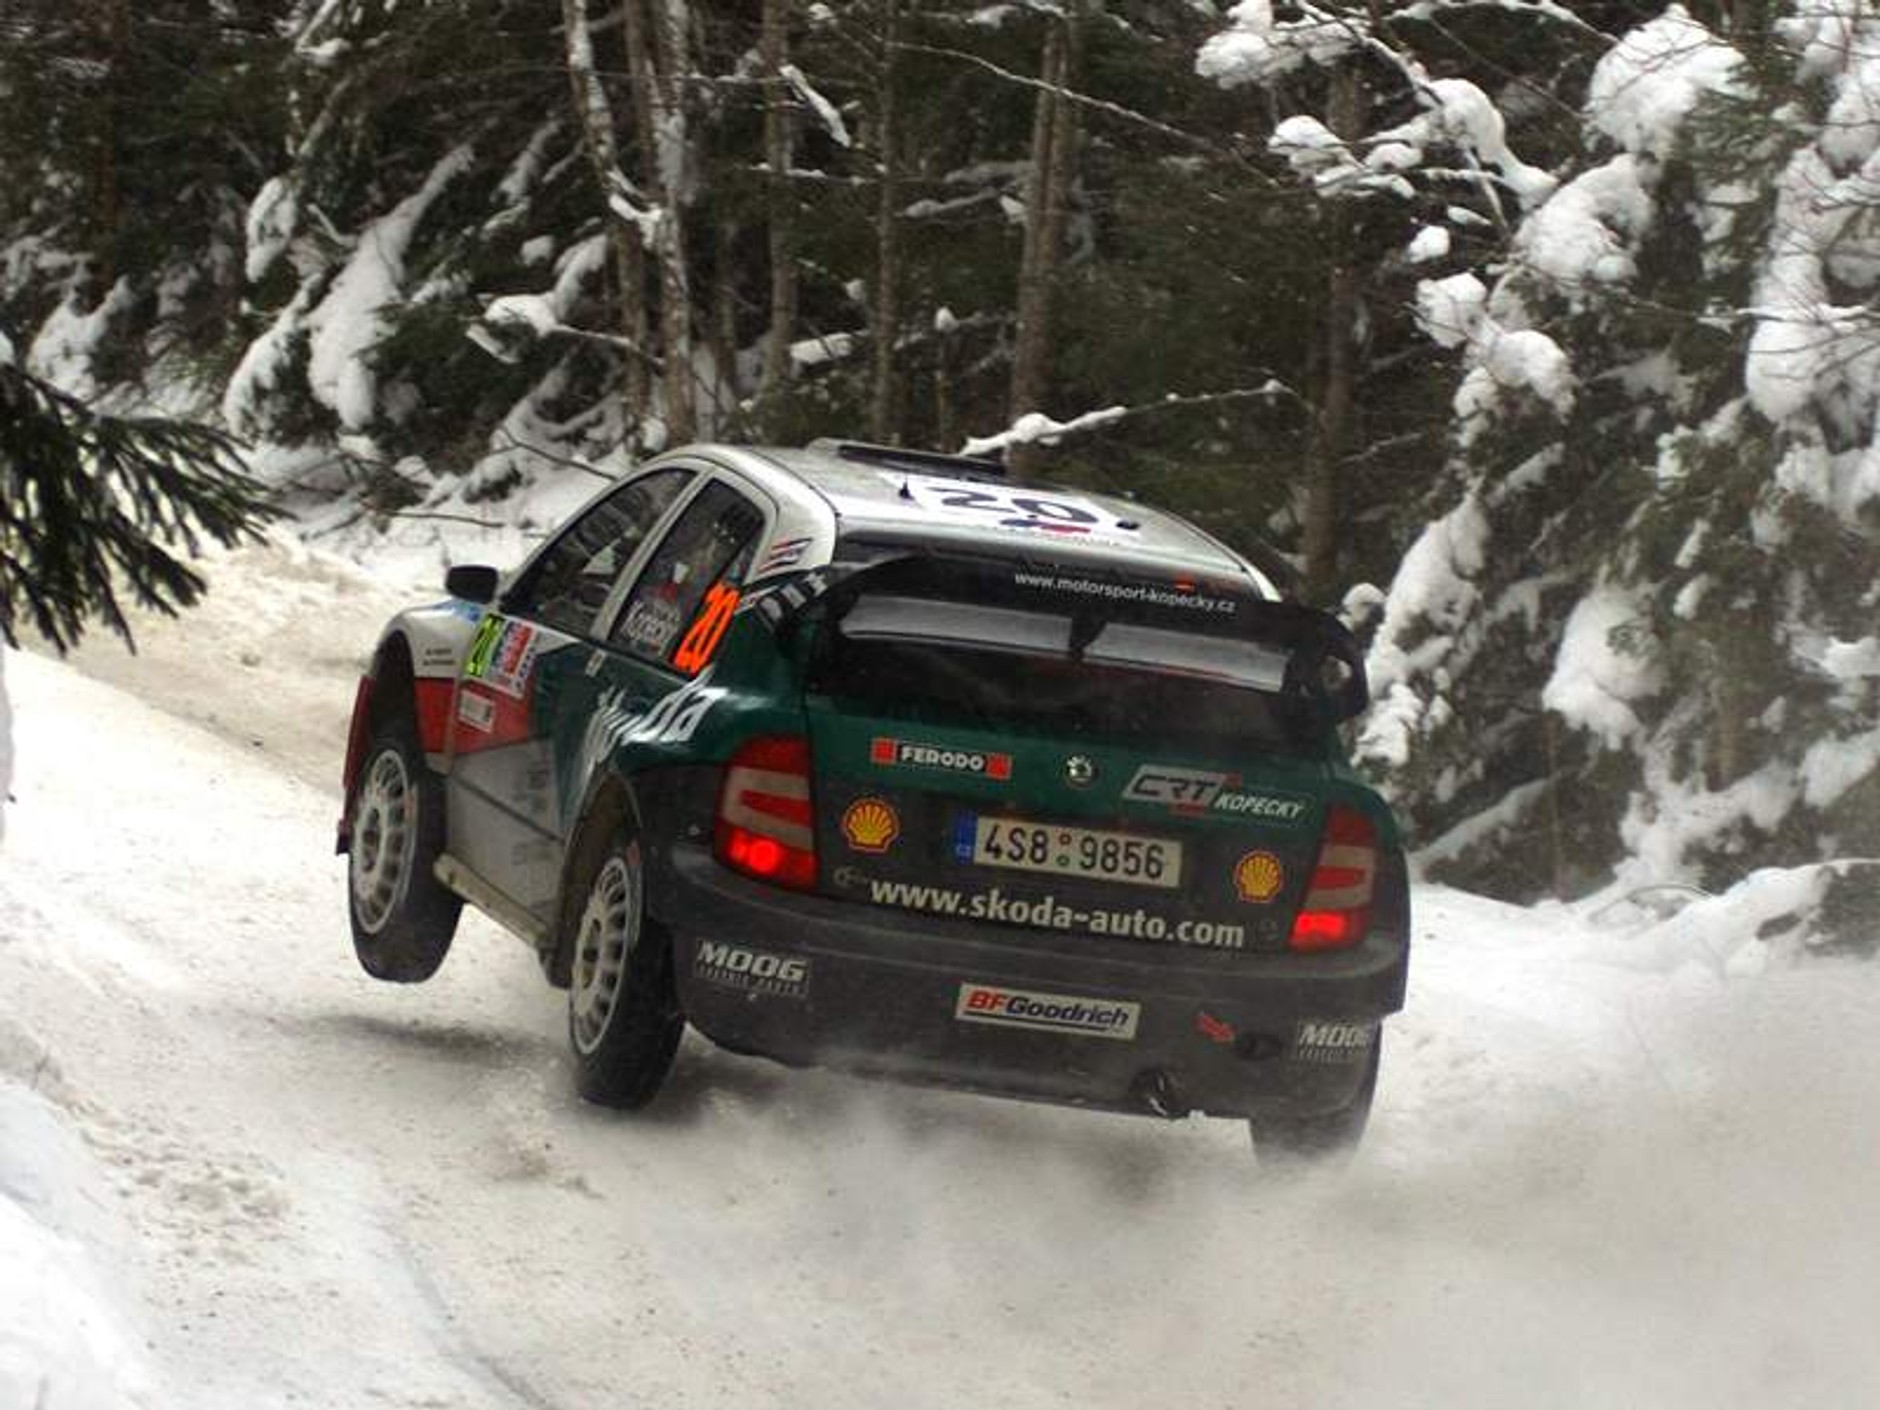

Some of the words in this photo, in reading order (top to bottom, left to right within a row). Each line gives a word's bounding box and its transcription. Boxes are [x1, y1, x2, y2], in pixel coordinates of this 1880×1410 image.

[926, 487, 1100, 523] 20
[1014, 573, 1236, 614] www.motorsport-kopecky.cz
[902, 746, 985, 771] FERODO
[1133, 774, 1219, 801] CRT
[983, 823, 1048, 865] 4S8
[1079, 835, 1165, 880] 9856
[871, 879, 1245, 948] www.skoda-auto.com
[697, 941, 807, 982] MOOG
[967, 989, 1130, 1027] BFGoodrich
